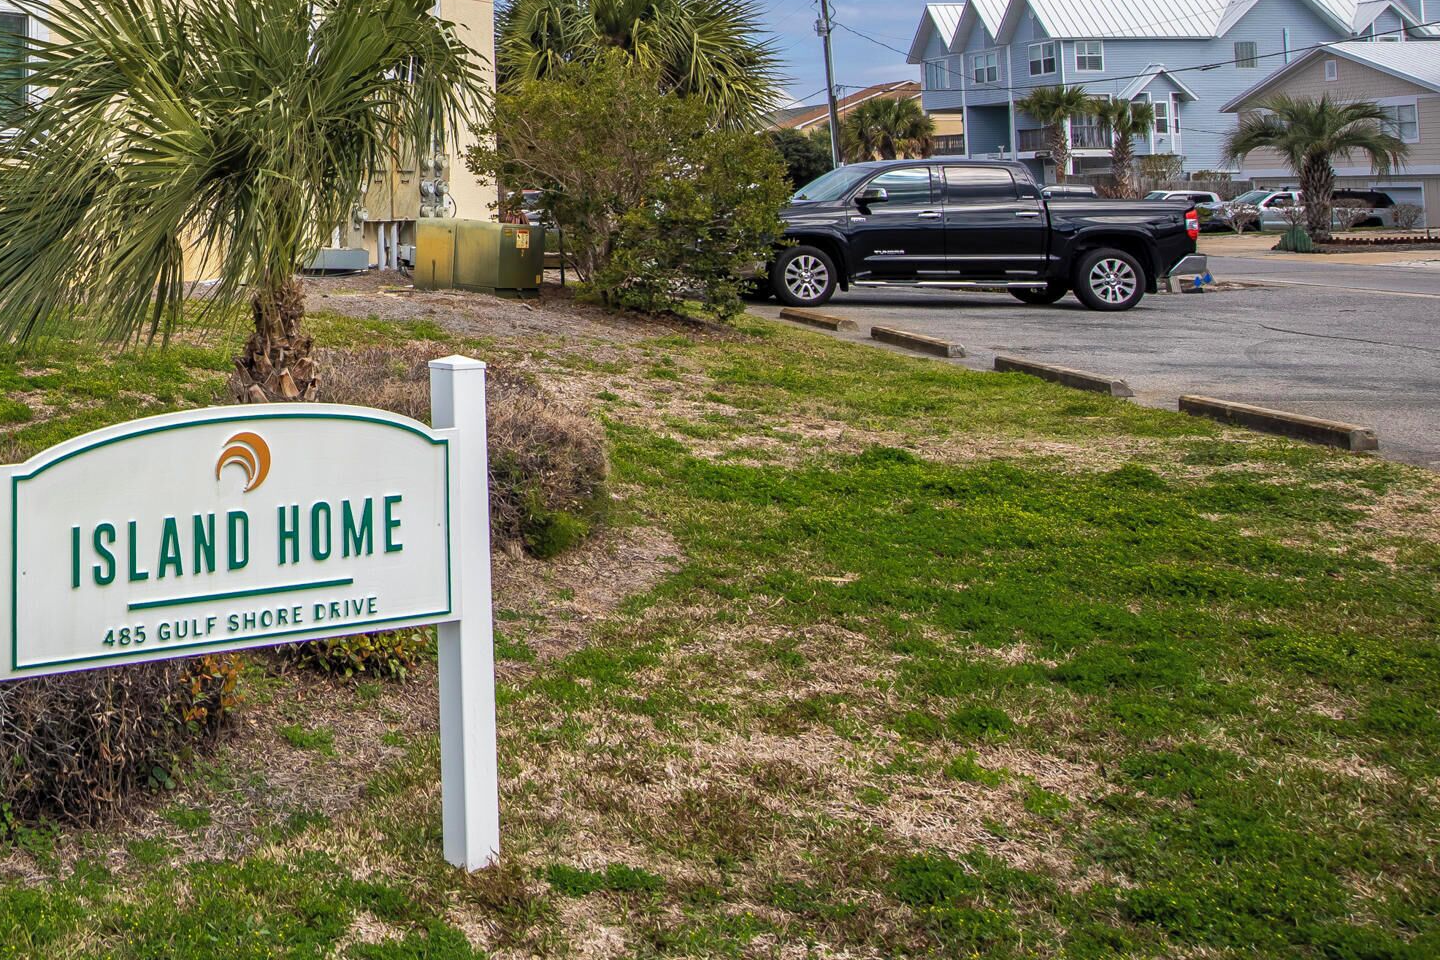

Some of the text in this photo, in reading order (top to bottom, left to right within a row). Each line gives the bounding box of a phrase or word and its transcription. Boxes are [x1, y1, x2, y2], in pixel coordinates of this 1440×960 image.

[70, 494, 404, 589] ISLAND HOME
[101, 596, 380, 648] 485 GULF SHORE DRIVE
